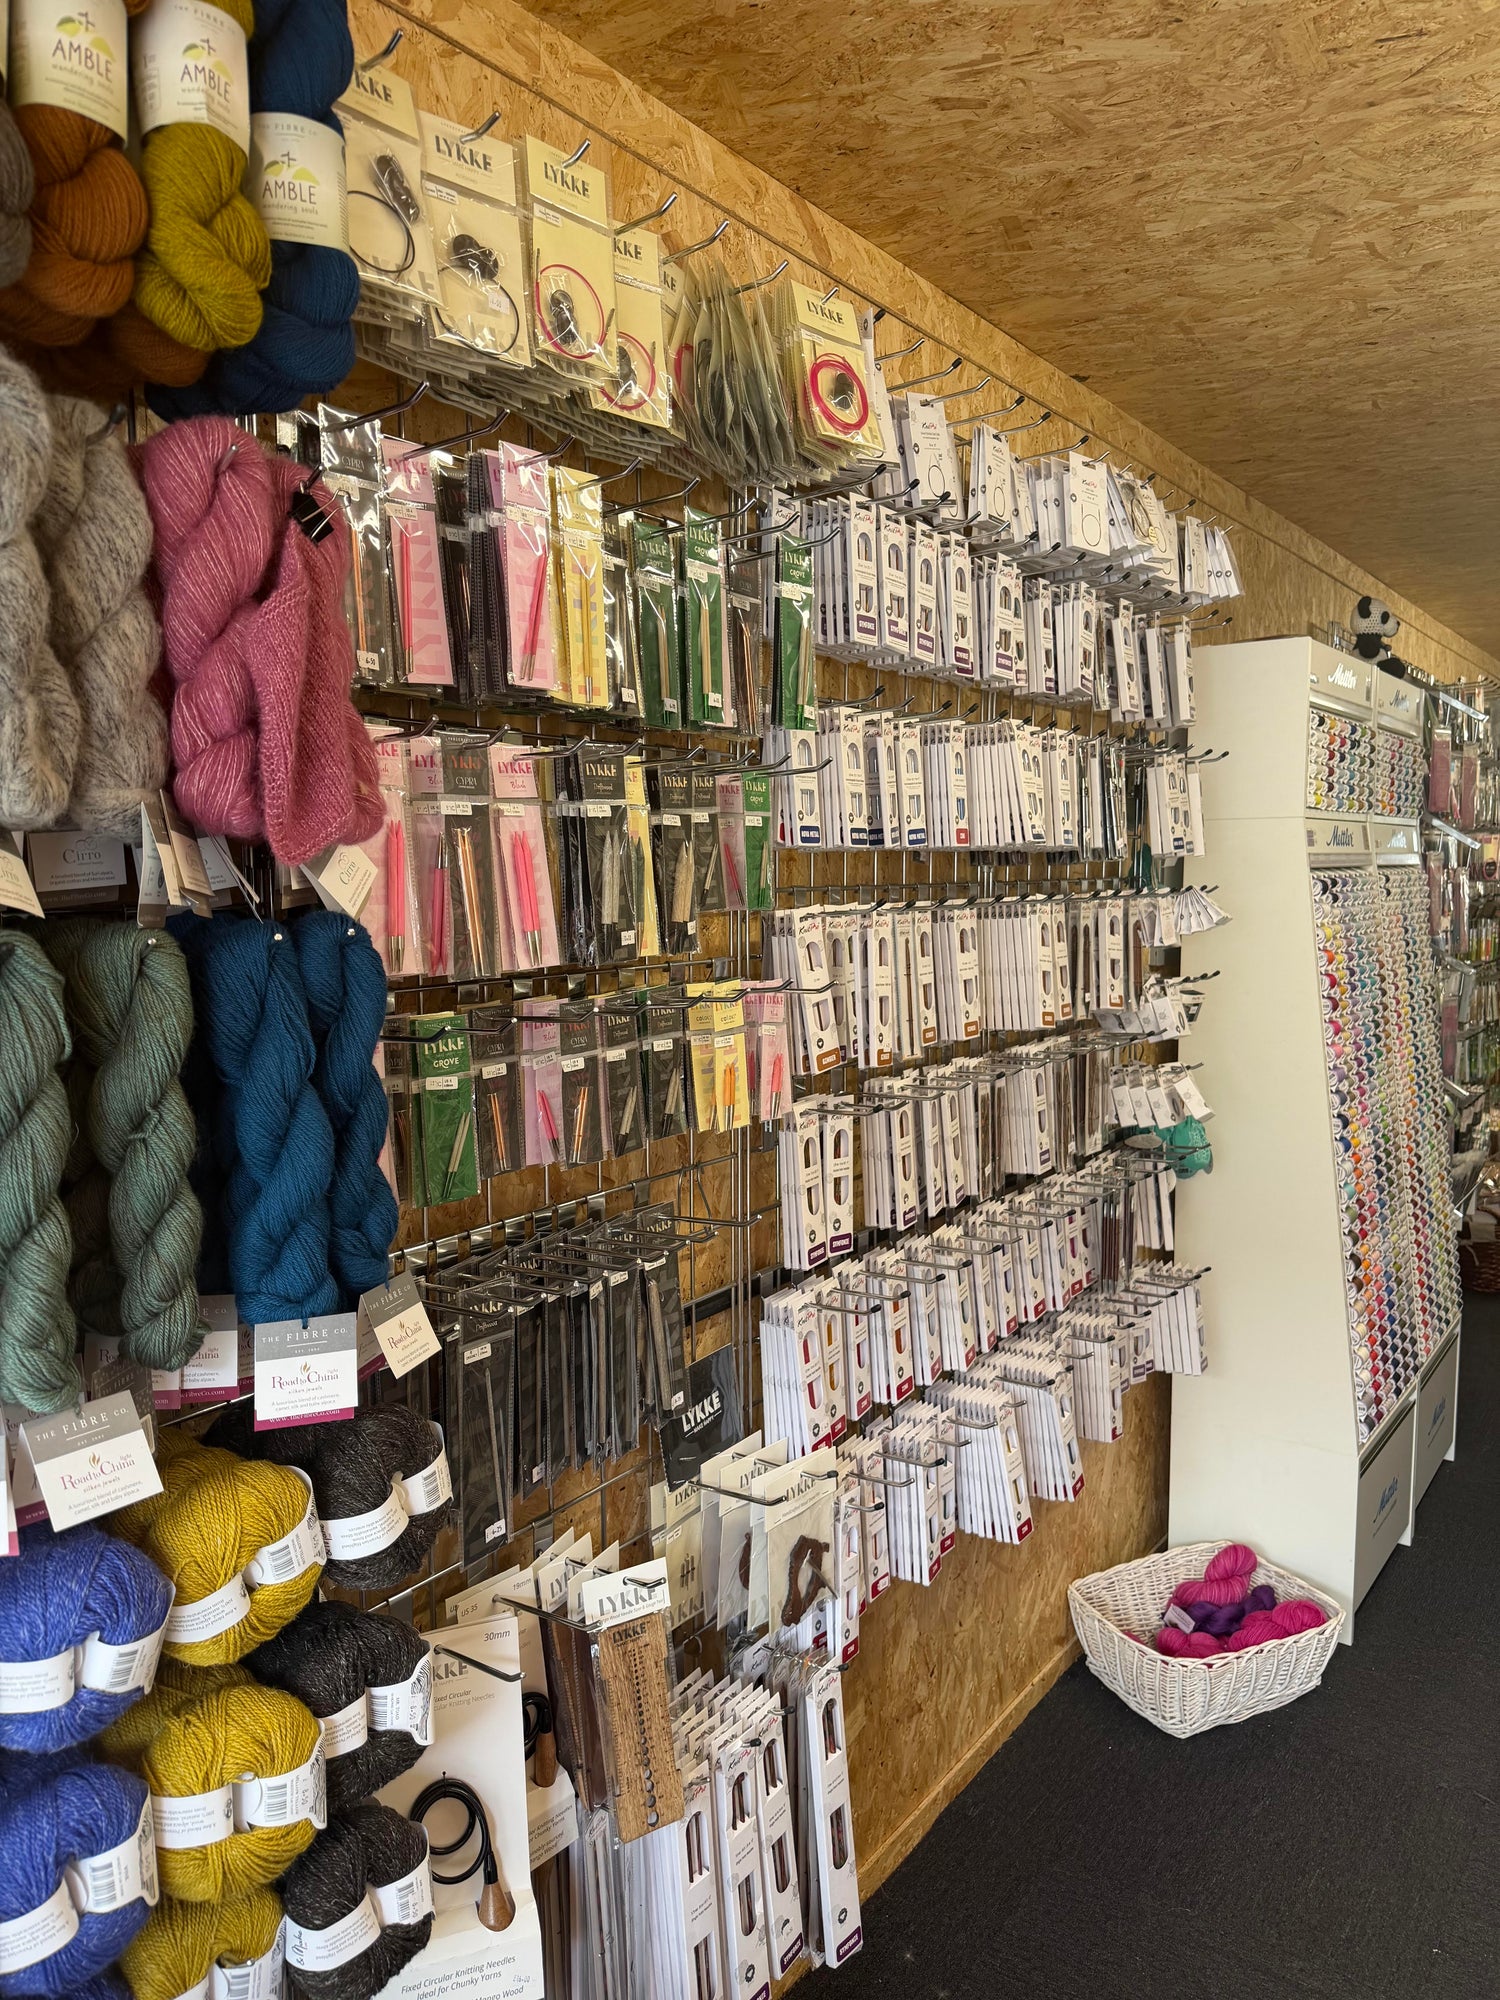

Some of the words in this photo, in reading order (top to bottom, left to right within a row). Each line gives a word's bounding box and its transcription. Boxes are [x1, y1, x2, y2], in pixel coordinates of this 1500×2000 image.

[52, 38, 113, 83] AMBLE
[180, 64, 232, 103] AMBLE
[353, 69, 394, 102] KKE
[435, 135, 493, 174] LYKKE
[544, 161, 590, 199] LYKKE
[263, 180, 317, 205] AMBLE
[612, 236, 643, 262] KKE
[806, 299, 845, 326] LYKKE
[388, 458, 429, 476] LYKKE
[507, 460, 542, 484] LYE
[689, 525, 716, 544] LYKKE
[639, 539, 668, 556] LYKKE
[372, 743, 399, 757] KKE
[497, 761, 532, 775] LYKKE
[585, 763, 617, 777] LYKKE
[455, 776, 477, 786] CYPRA
[663, 775, 688, 788] LYKKE
[694, 775, 714, 788] YKKE
[745, 780, 767, 792] LYKKE
[1326, 825, 1354, 847] Mettler
[62, 848, 102, 865] Cirro
[339, 861, 357, 885] Cirro
[716, 1001, 739, 1012] LYKKE
[608, 1015, 631, 1026] LYKKE
[424, 1036, 465, 1055] LYKKE
[433, 1057, 459, 1069] GROVE
[381, 1288, 402, 1305] FIBRE
[287, 1328, 329, 1342] FIBRE
[334, 1327, 348, 1335] CO.
[272, 1375, 299, 1390] Road
[299, 1377, 307, 1385] to
[307, 1370, 339, 1384] China
[682, 1390, 721, 1433] LYKKE
[36, 1431, 56, 1442] THE
[62, 1411, 109, 1434] FIBRE
[114, 1407, 129, 1417] CO.
[60, 1471, 93, 1490] Road
[93, 1470, 101, 1480] to
[100, 1457, 136, 1476] China
[513, 1578, 532, 1591] 19mm
[461, 1609, 470, 1618] US
[470, 1603, 478, 1614] 35
[598, 1587, 656, 1617] LYKKE
[483, 1629, 511, 1642] 30mm
[612, 1622, 647, 1644] LYKKE
[432, 1660, 469, 1682] KKE
[448, 1688, 472, 1701] Circular
[448, 1696, 471, 1708] Knitting
[471, 1691, 496, 1702] Needles
[401, 1981, 422, 1994] Fixed
[423, 1971, 454, 1988] Circular
[455, 1962, 485, 1979] Knitting
[486, 1954, 516, 1970] Needles
[416, 1986, 436, 2000] Ideal
[437, 1983, 449, 1998] for
[450, 1974, 479, 1991] Chunky
[480, 1969, 502, 1983] Yarns
[502, 1984, 524, 1998] Wood
